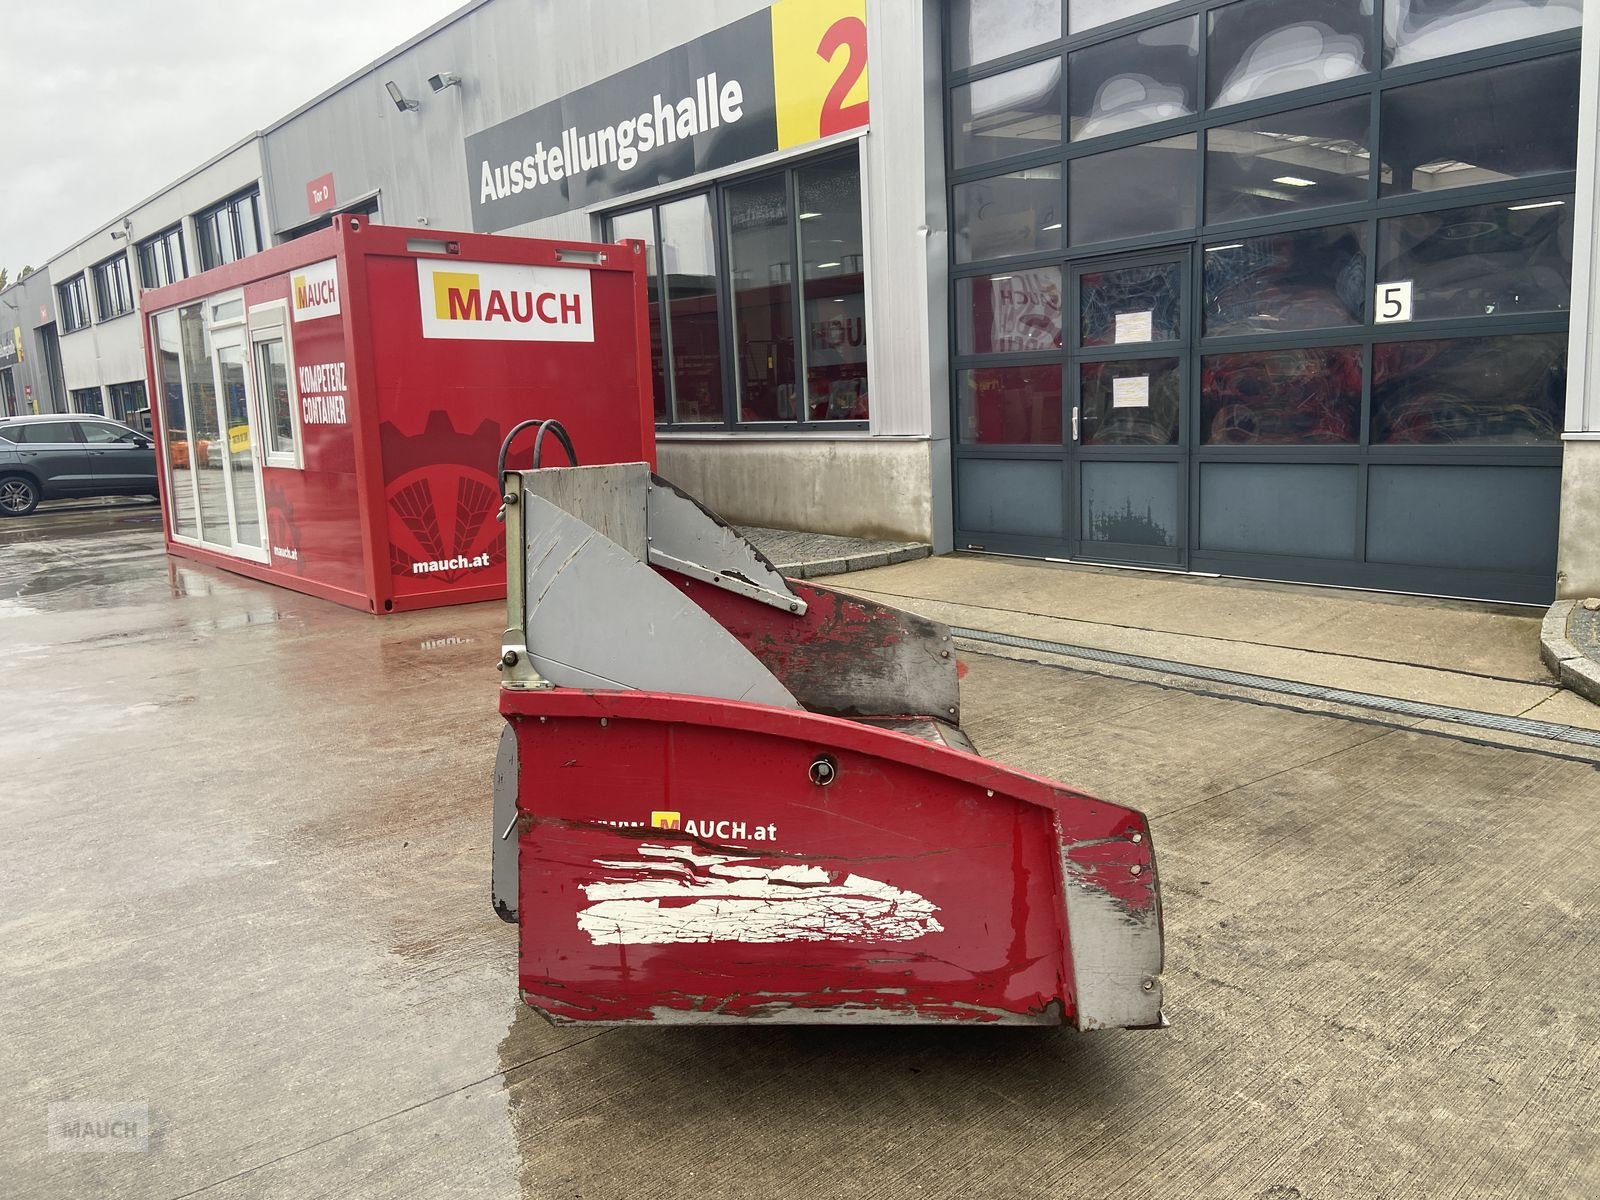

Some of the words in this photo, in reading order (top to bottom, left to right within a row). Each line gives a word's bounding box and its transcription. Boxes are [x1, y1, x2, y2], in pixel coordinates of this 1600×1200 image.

[480, 72, 744, 205] Ausstellungshalle
[816, 16, 869, 139] 2
[312, 190, 323, 204] Tor
[298, 278, 336, 310] MAUCH
[447, 287, 582, 325] MAUCH
[1383, 288, 1402, 318] 5
[299, 361, 348, 394] KOMPETENZ
[302, 395, 347, 425] CONTAINER
[412, 552, 490, 574] mauch.at
